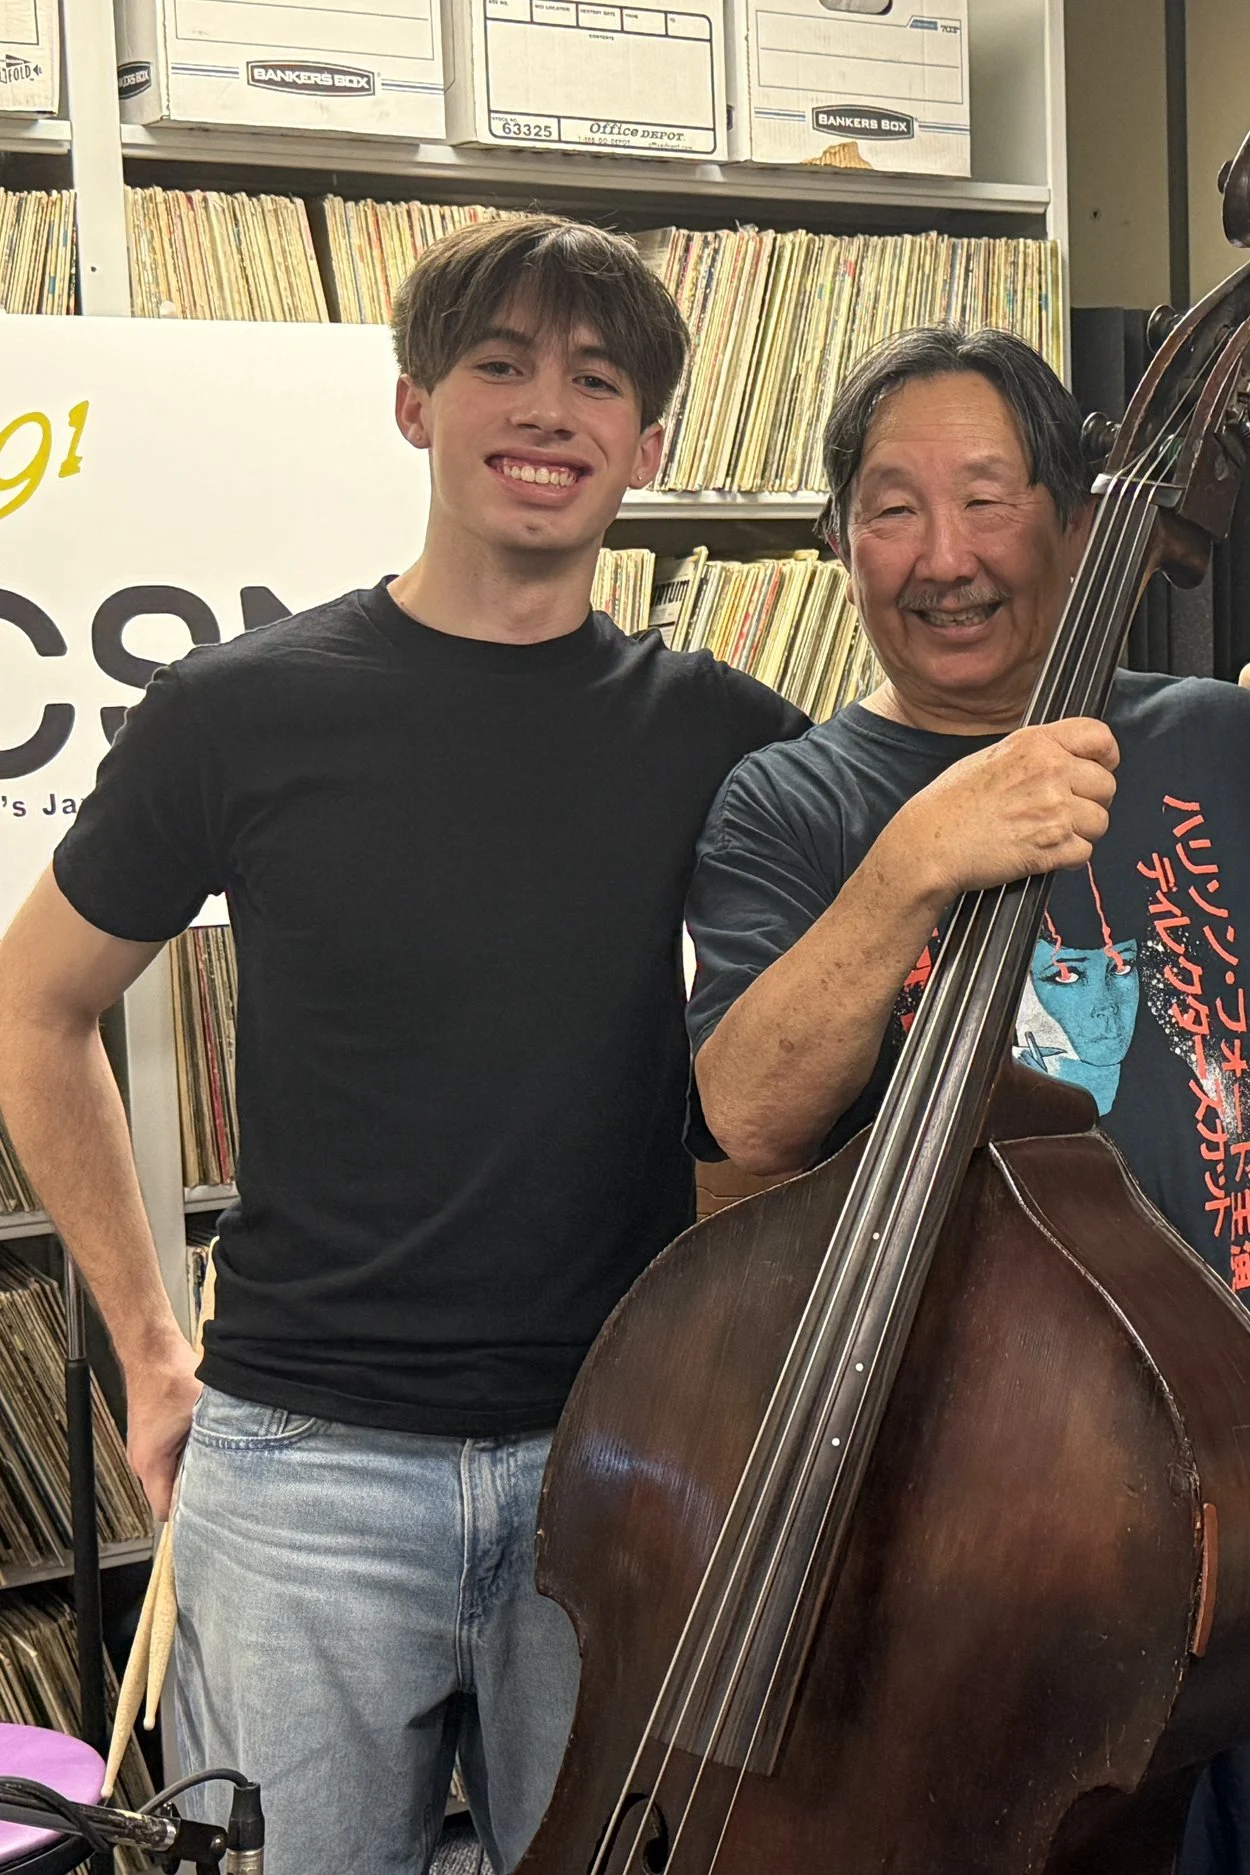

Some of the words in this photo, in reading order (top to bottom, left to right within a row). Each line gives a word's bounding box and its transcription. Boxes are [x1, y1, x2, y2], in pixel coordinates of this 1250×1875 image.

[253, 68, 333, 86] BANKERS
[334, 74, 369, 89] BOX
[502, 121, 553, 138] 63325
[590, 122, 639, 138] Office
[818, 113, 878, 130] BANKERS
[881, 119, 908, 132] BOX
[0, 585, 297, 779] CS
[42, 793, 85, 815] Ja
